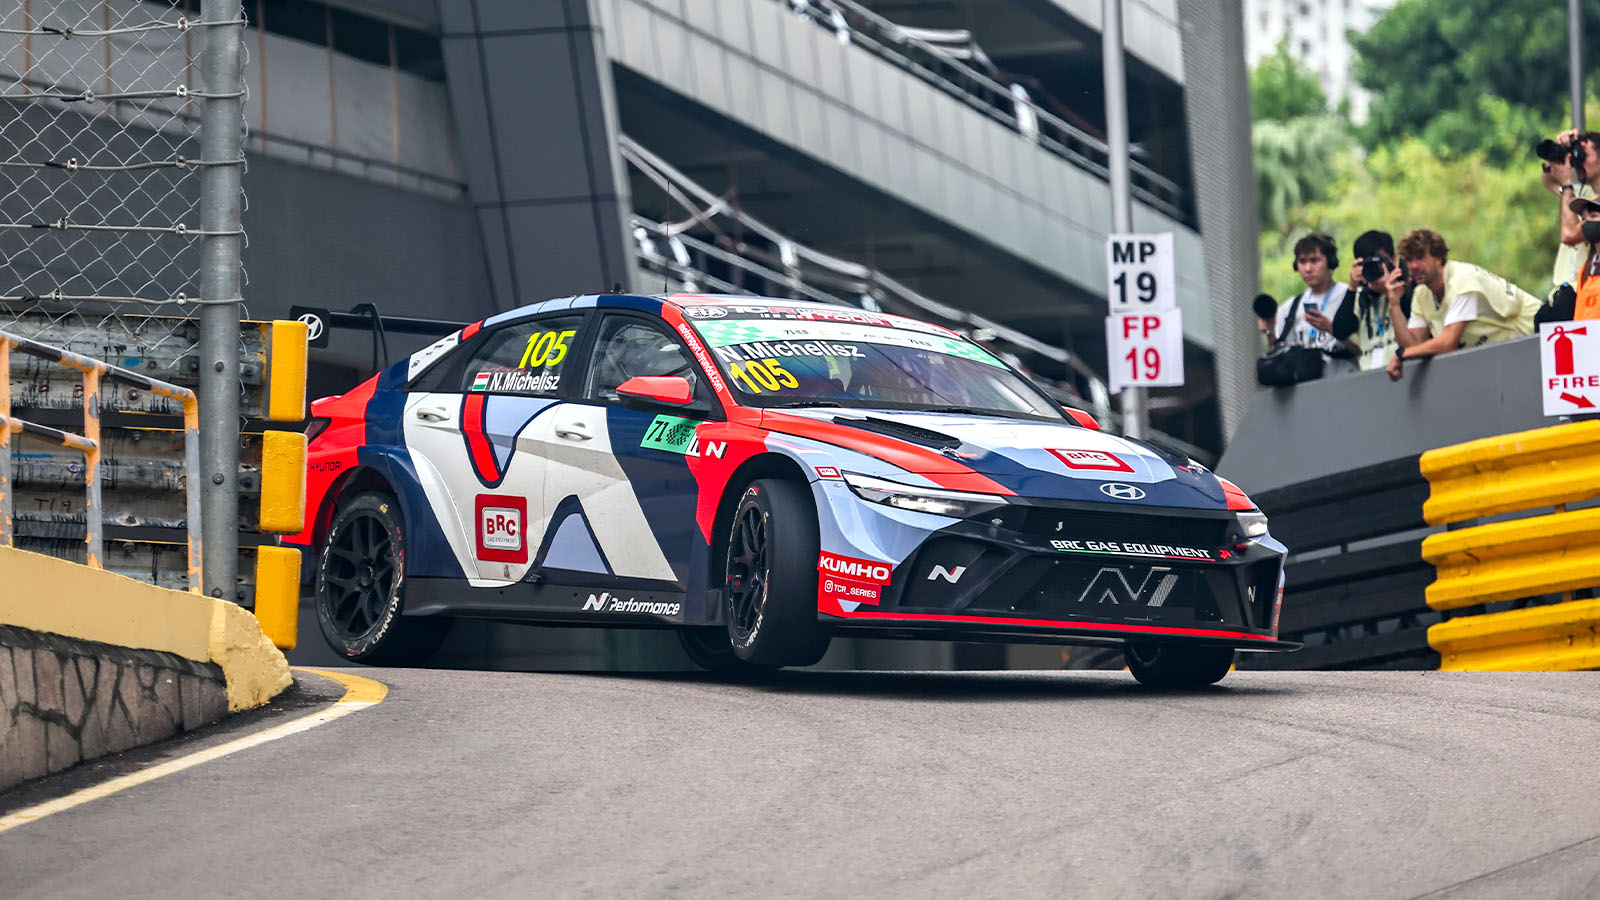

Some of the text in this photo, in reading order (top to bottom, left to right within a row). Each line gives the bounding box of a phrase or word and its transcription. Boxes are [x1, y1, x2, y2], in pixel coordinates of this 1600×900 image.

[1112, 241, 1156, 264] MP
[1113, 272, 1157, 303] 19
[1123, 316, 1161, 339] FP
[518, 330, 576, 368] 105
[677, 323, 723, 393] motorsport.hyundai.com
[712, 341, 866, 363] N.Michelisz
[1125, 347, 1161, 381] 19
[488, 372, 560, 391] N.Michelisz
[730, 358, 799, 394] 105
[1548, 375, 1600, 391] FIRE
[646, 420, 670, 443] 71
[705, 441, 728, 459] N
[1066, 452, 1108, 461] BRC
[311, 461, 342, 472] HYUNDAI
[487, 514, 516, 537] BRC
[1050, 540, 1210, 559] BRC GAS EQUIPMENT
[820, 555, 890, 580] KUMHO
[834, 583, 877, 599] TCR_SERIES
[609, 597, 681, 615] Performance
